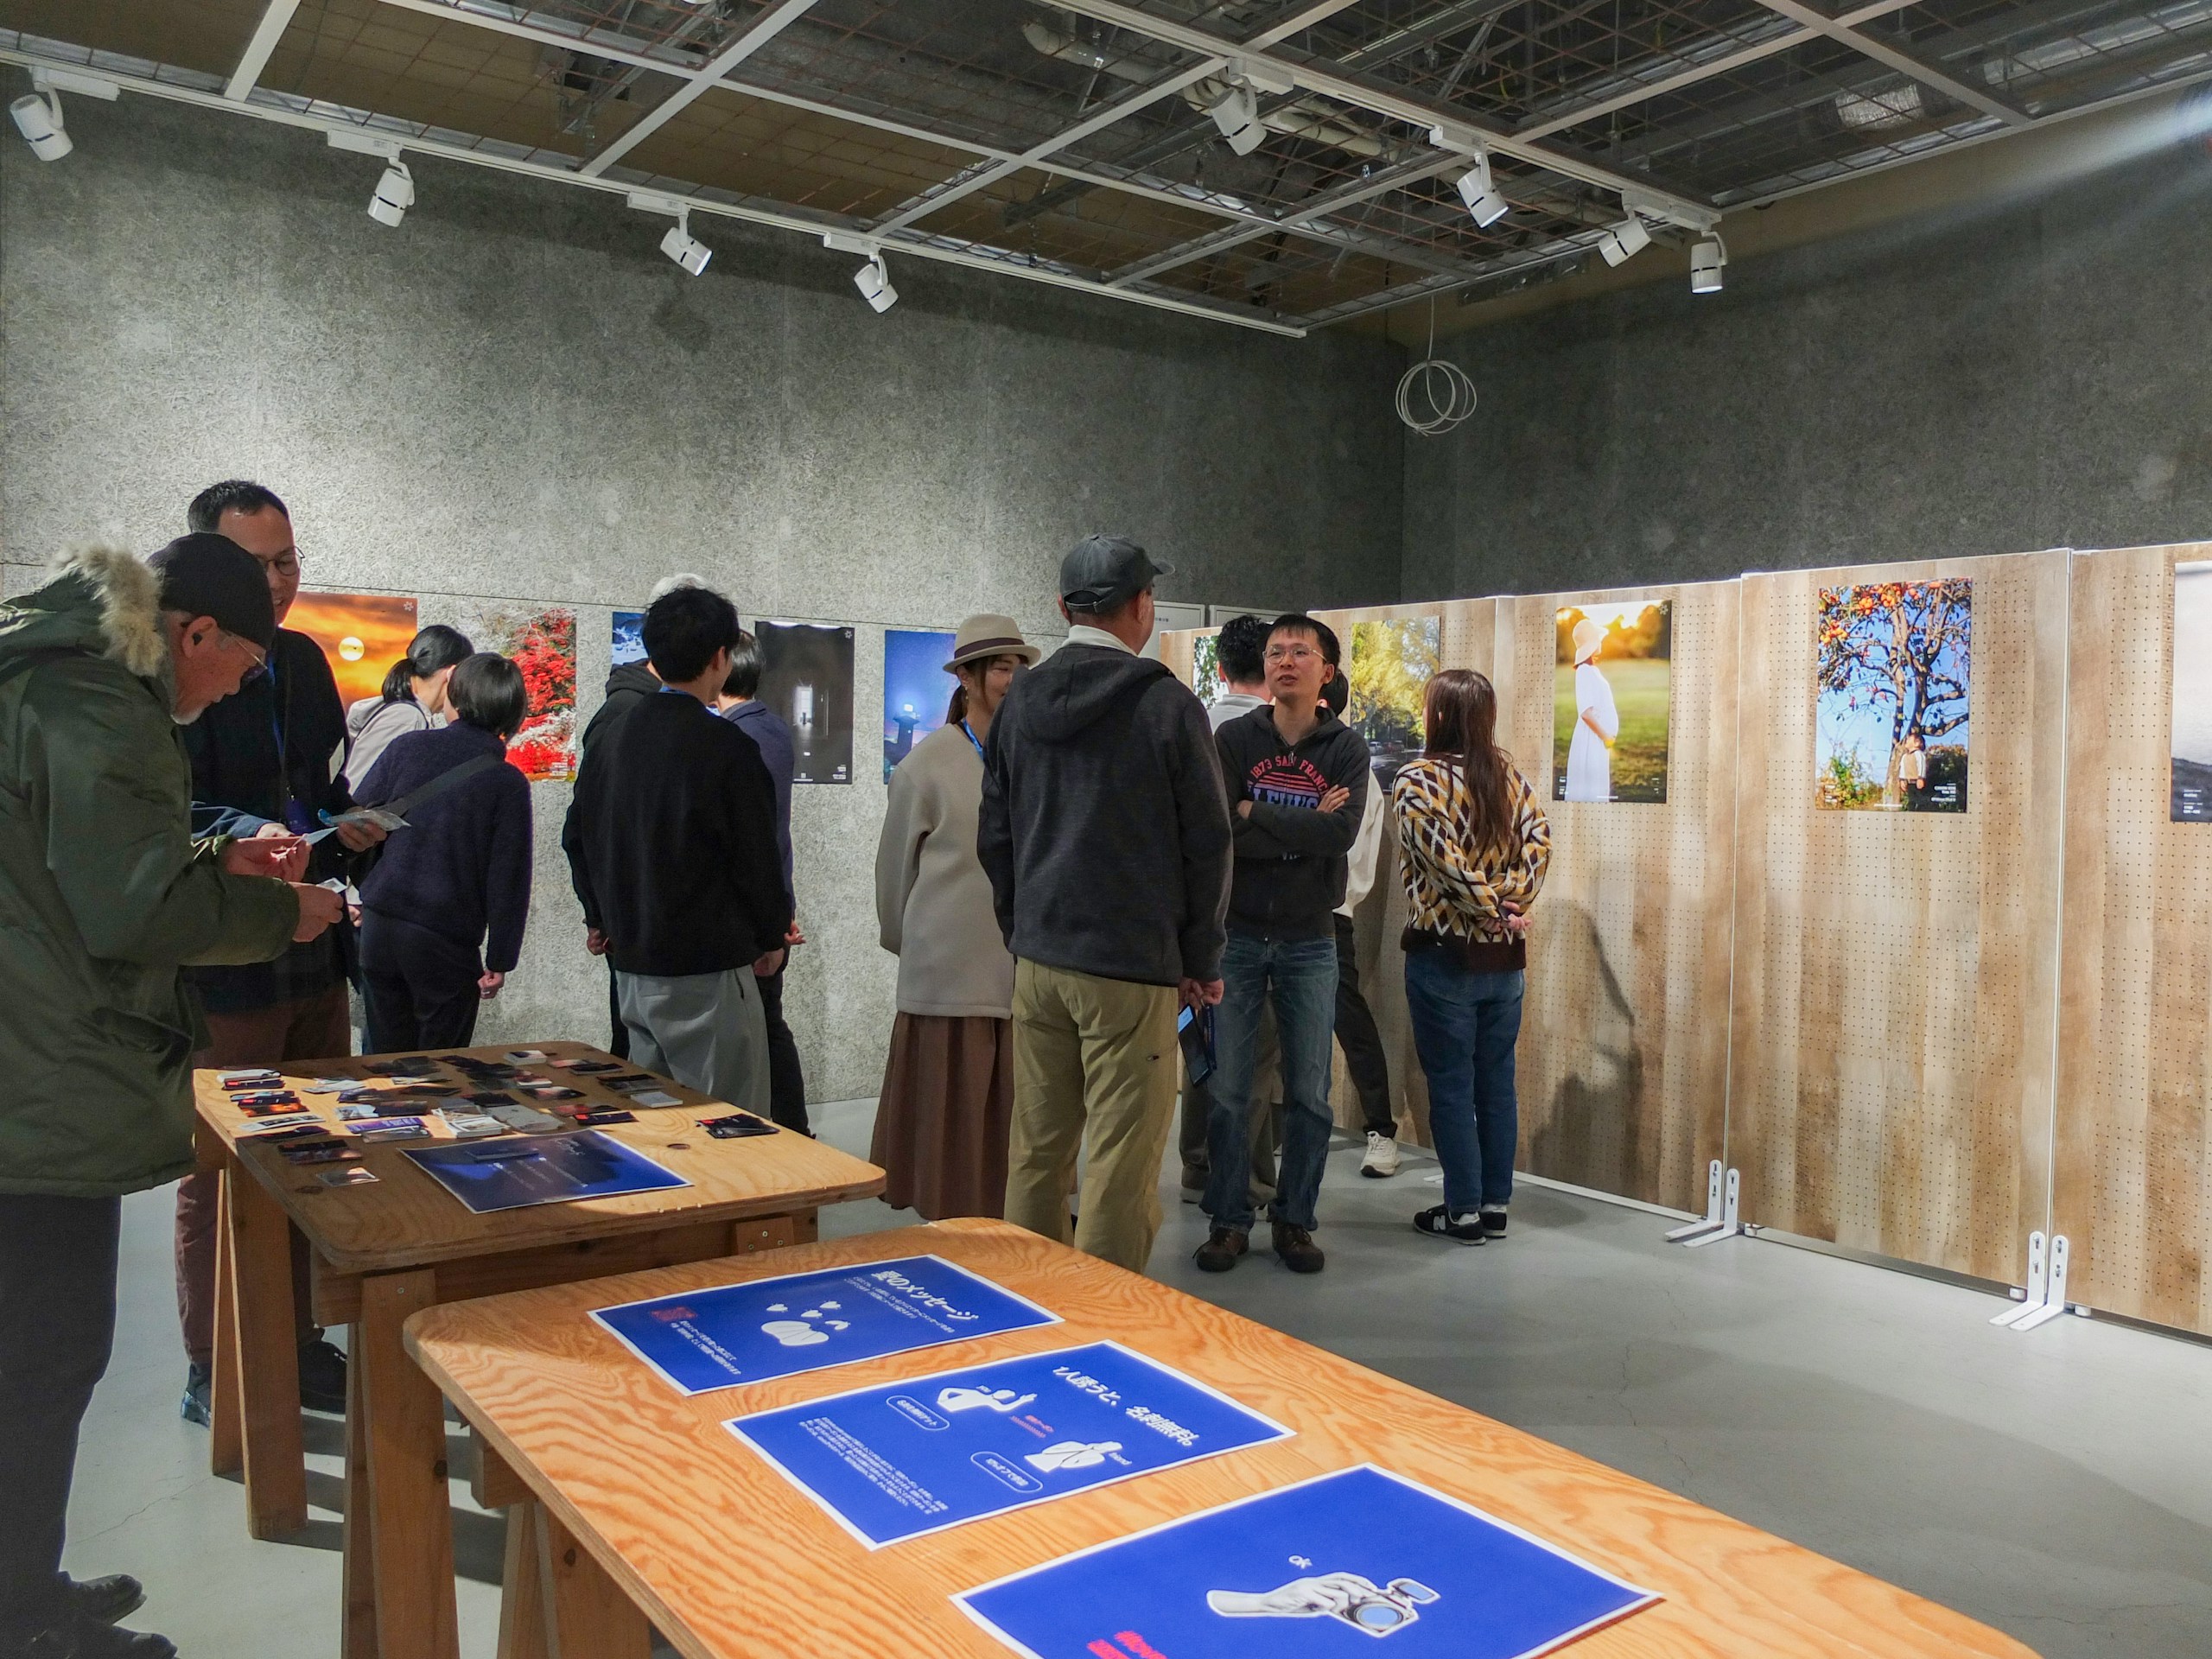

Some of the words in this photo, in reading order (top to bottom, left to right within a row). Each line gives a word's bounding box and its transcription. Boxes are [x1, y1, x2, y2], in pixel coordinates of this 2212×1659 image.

[1250, 758, 1272, 779] 1873
[1433, 1215, 1446, 1230] N
[871, 1270, 979, 1319] 愛のメッセージ
